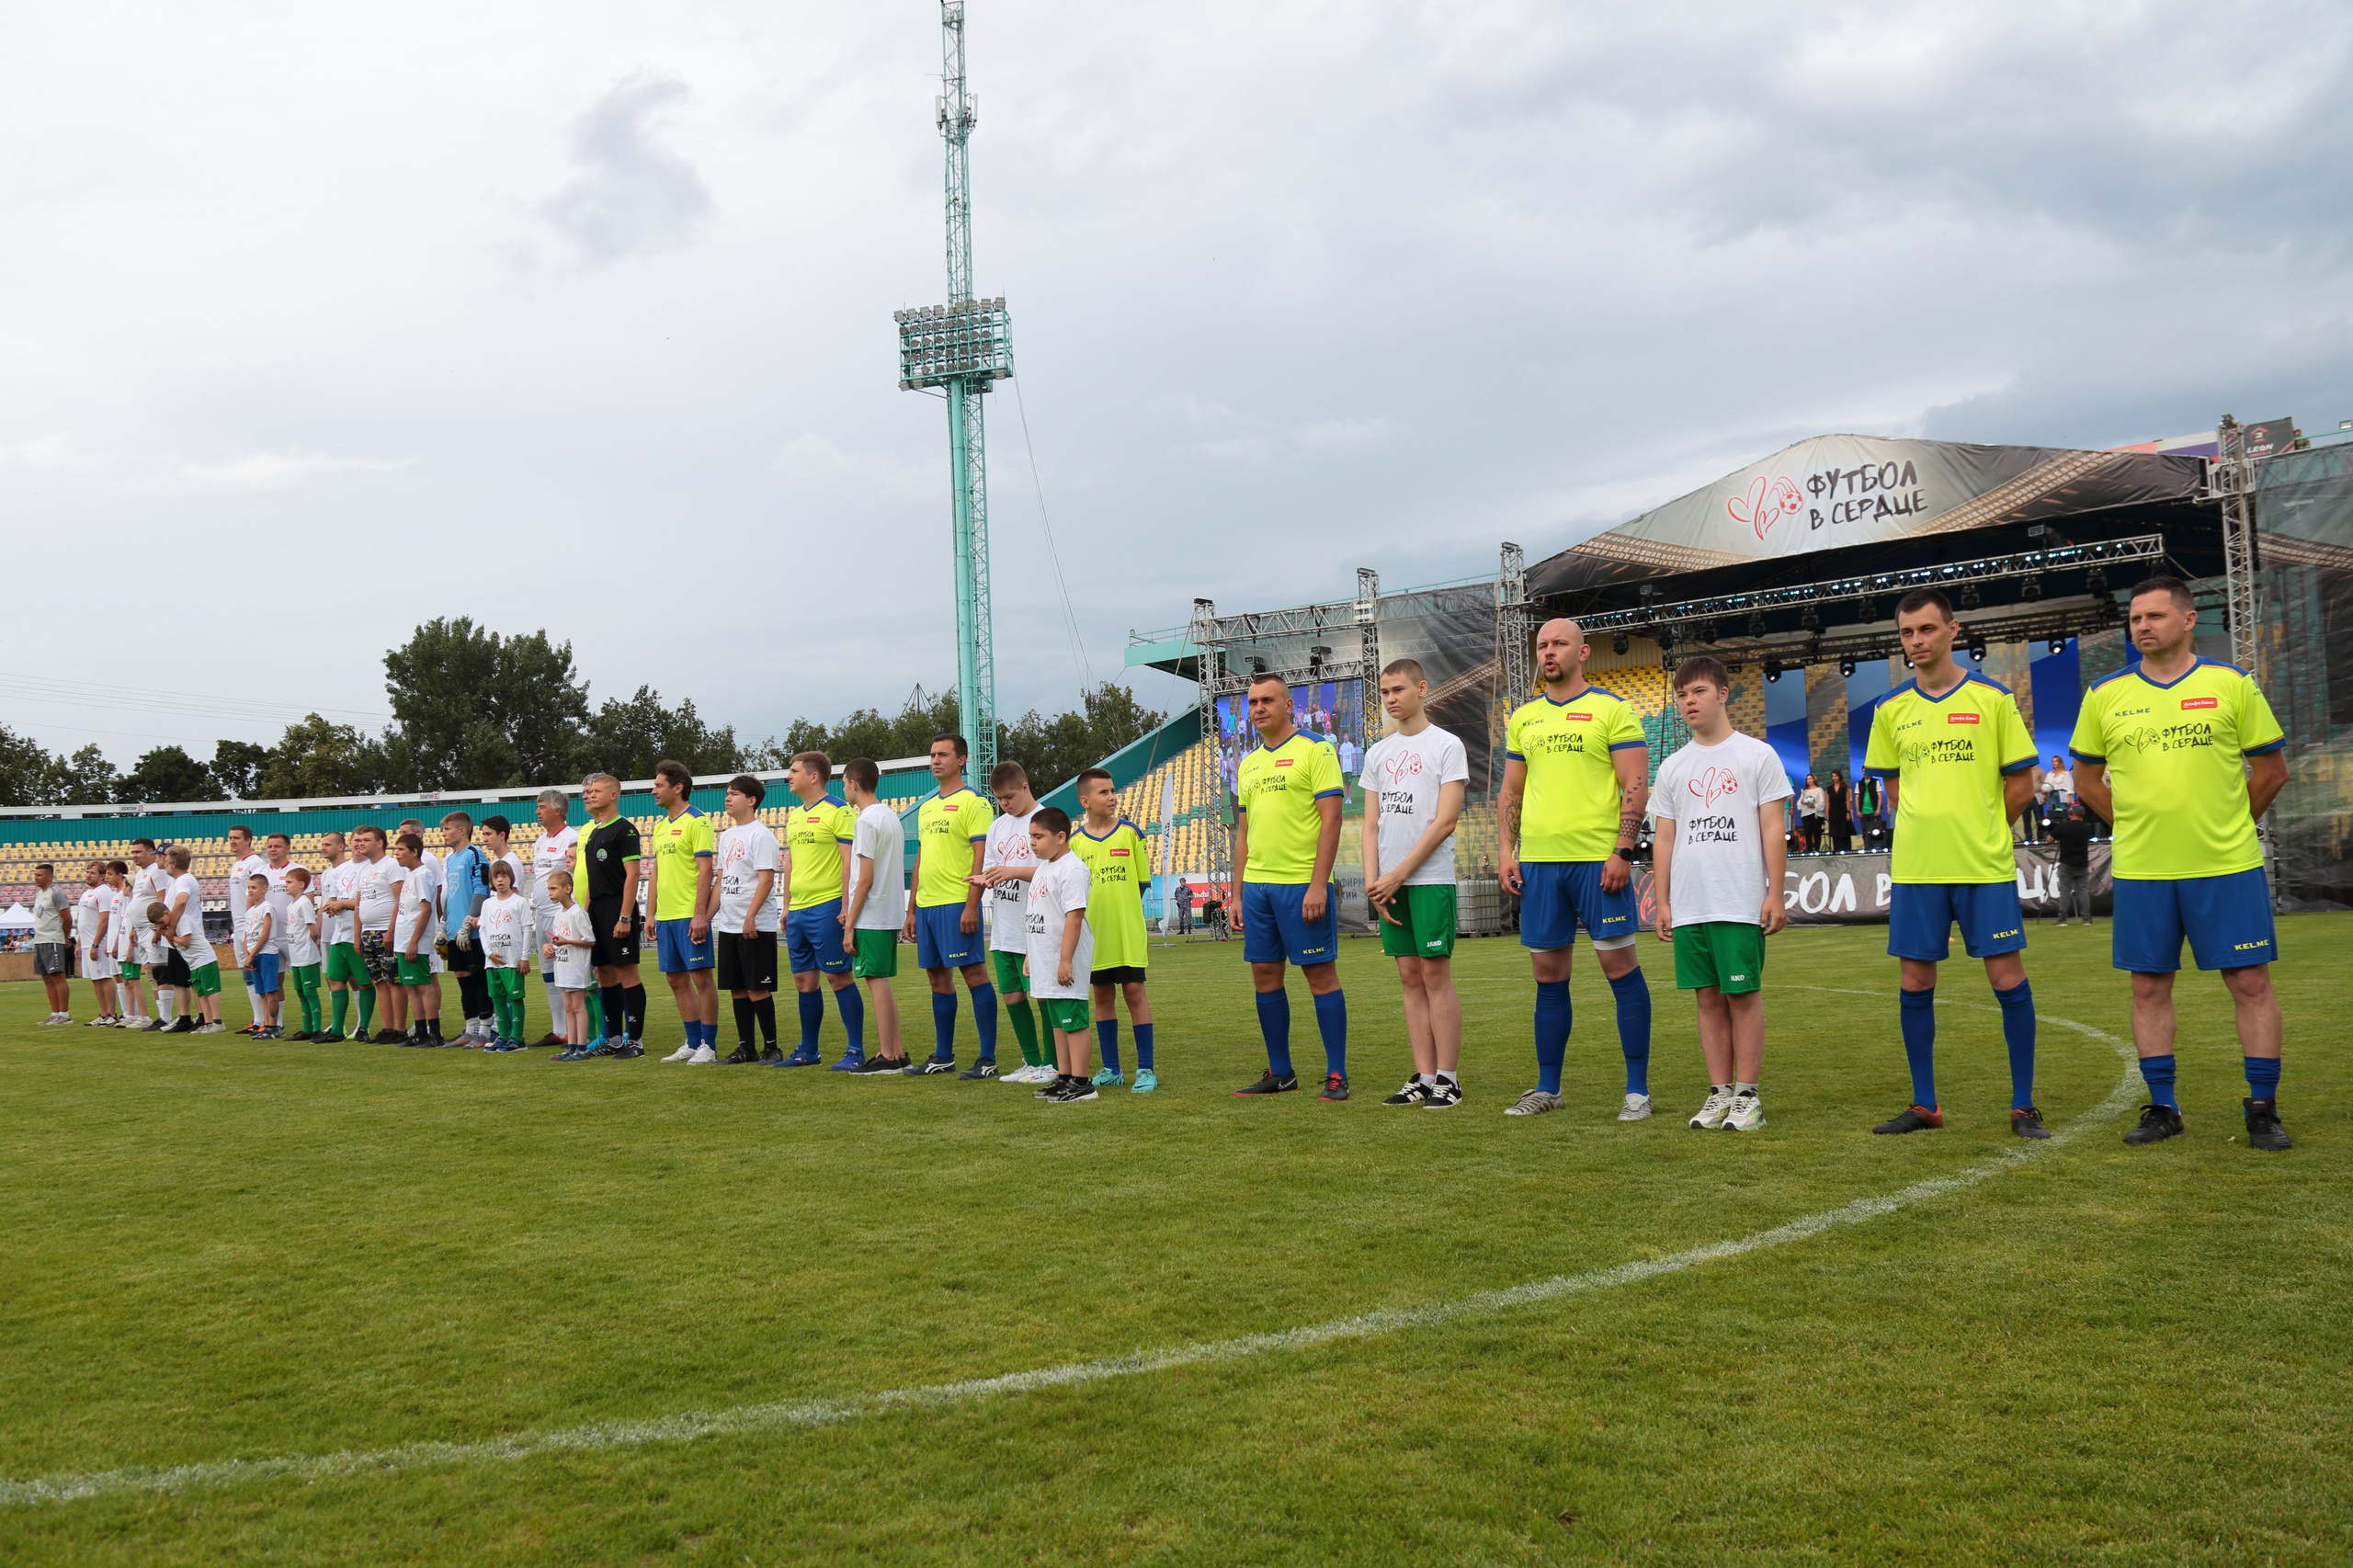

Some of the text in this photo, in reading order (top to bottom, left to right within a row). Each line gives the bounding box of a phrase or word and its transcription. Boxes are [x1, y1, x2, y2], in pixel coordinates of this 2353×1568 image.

[2246, 443, 2274, 454] LEON
[1806, 460, 1917, 500] ФУТБОЛ
[1810, 489, 1928, 530] В СЕРДЦЕ
[2115, 708, 2151, 717] KELME
[1522, 719, 1544, 727] KELME
[1897, 720, 1923, 732] KELME
[2162, 723, 2211, 738] ФУТБОЛ
[1547, 733, 1583, 744] ФУТБОЛ
[2163, 735, 2213, 751] В СЕРДЦЕ
[1547, 744, 1585, 754] В СЕРДЦЕ
[1930, 739, 1972, 752] ФУТБОЛ
[1931, 751, 1975, 764] В СЕРДЦЕ
[1262, 775, 1286, 786] ФУТБОЛ
[1266, 785, 1288, 793] СЕРДЦЕ
[1385, 803, 1415, 814] ЕРДЦЕ
[1688, 815, 1735, 831] ФУТБОЛ
[1688, 830, 1738, 846] В СЕРДЦЕ
[1100, 865, 1126, 875] ФУТБОЛ
[722, 875, 739, 885] ТБОЛ
[1107, 873, 1128, 882] СЕРДЦЕ
[1341, 877, 1365, 888] ФИРМ
[721, 886, 740, 895] ЕРДЦЕ
[994, 889, 1021, 903] ЕРДЦЕ
[1341, 889, 1358, 901] КИЙ
[1601, 915, 1627, 924] KELME
[1993, 929, 2018, 939] KELM
[1427, 939, 1442, 948] JAKO
[2234, 939, 2269, 950] KELME
[1302, 947, 1324, 955] KELME
